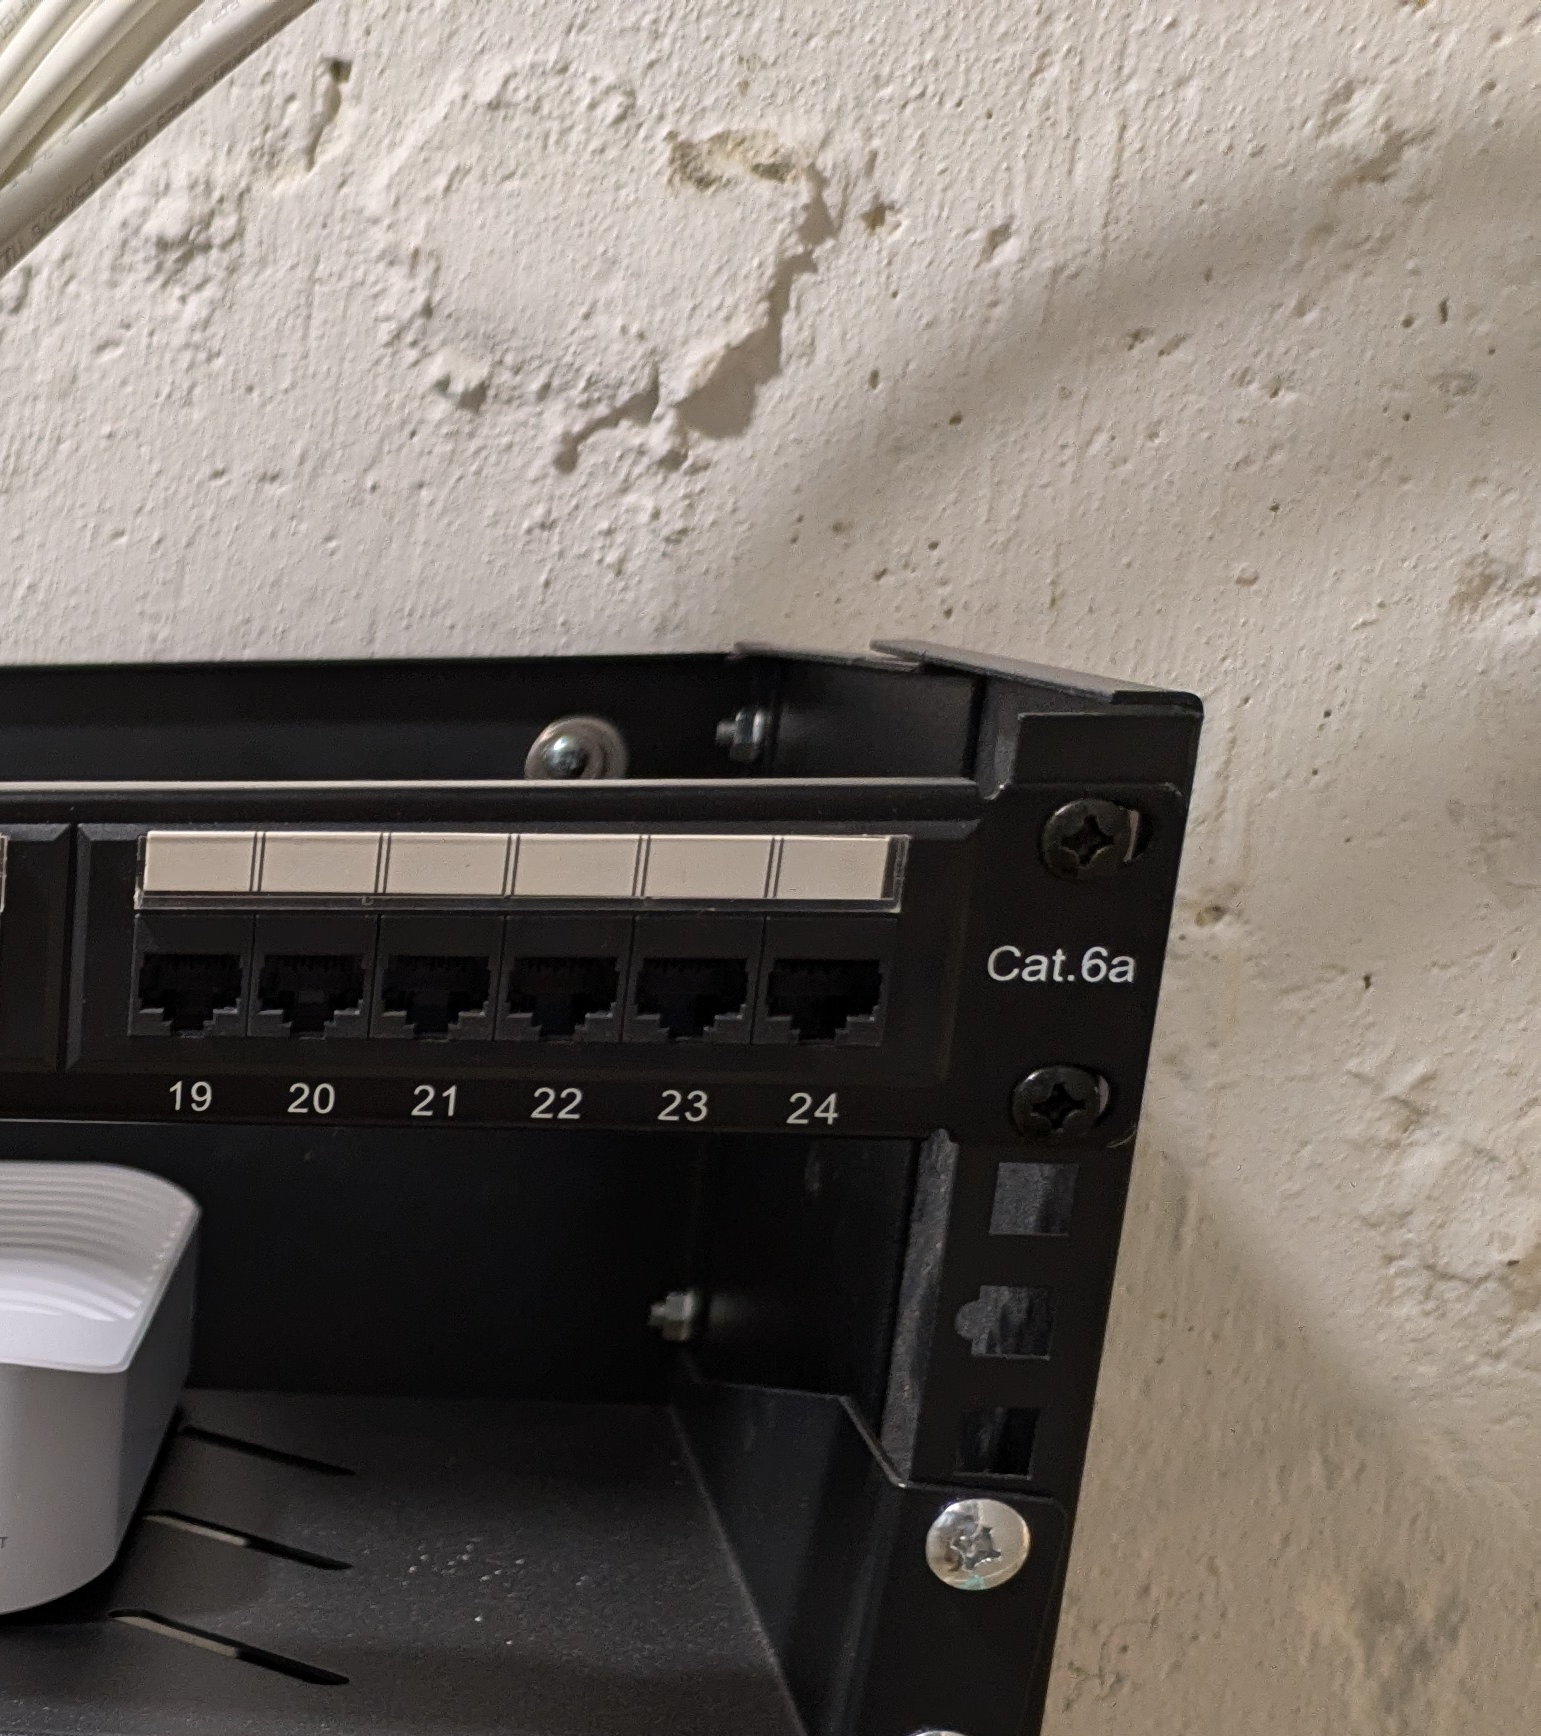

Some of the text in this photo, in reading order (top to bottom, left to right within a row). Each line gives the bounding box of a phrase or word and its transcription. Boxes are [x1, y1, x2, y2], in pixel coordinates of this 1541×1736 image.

[988, 946, 1134, 982] Cat.6a
[170, 1081, 211, 1111] 19
[288, 1083, 334, 1113] 20
[412, 1085, 456, 1116] 21
[531, 1088, 581, 1119] 22
[658, 1090, 707, 1121] 23
[787, 1093, 837, 1124] 24
